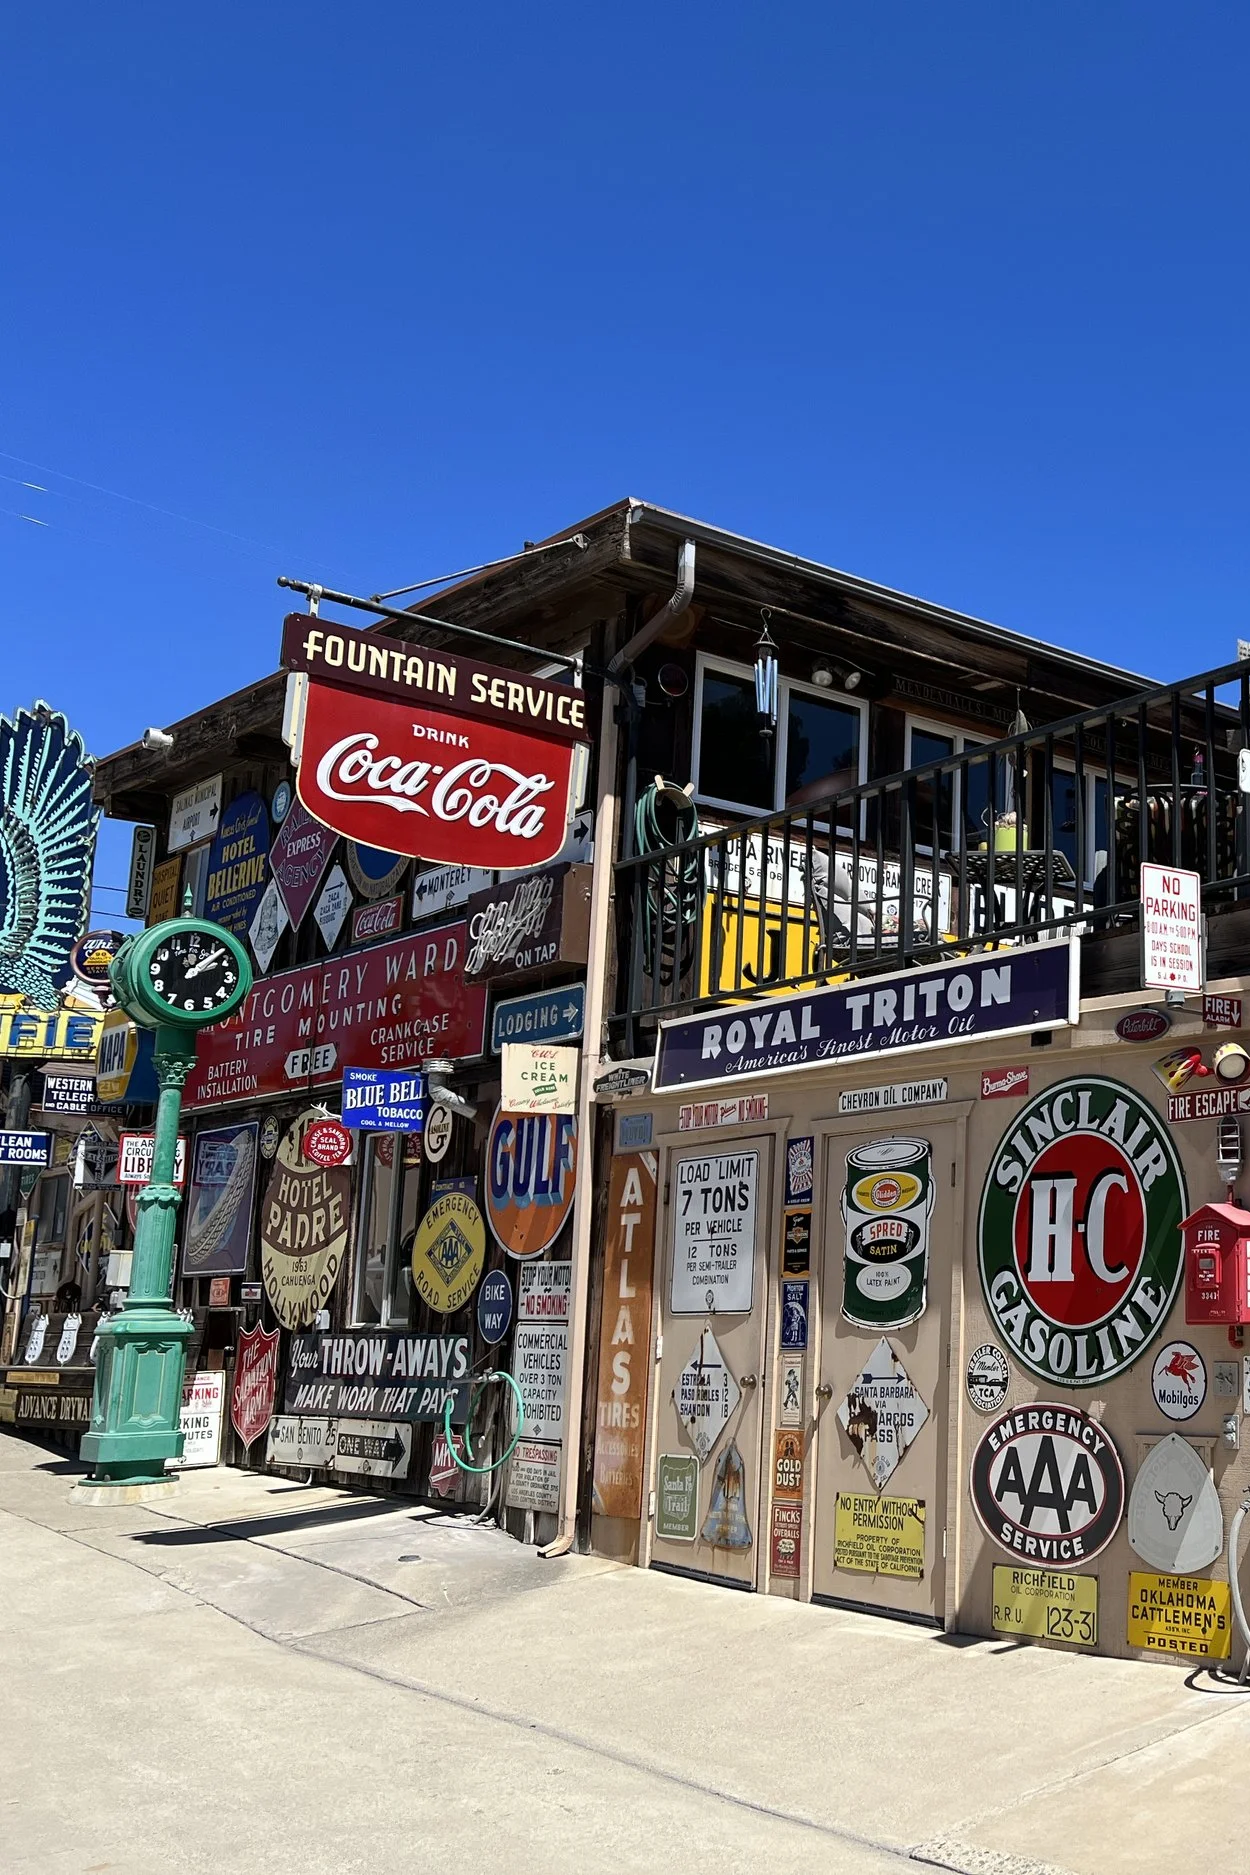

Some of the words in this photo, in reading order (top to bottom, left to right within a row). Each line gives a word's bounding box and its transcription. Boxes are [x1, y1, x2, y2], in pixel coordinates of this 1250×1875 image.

[303, 630, 457, 697] FOUNTAIN
[470, 673, 585, 729] SERVICE
[412, 723, 469, 748] DRINK
[316, 733, 555, 839] Coca-Cola
[222, 835, 255, 864] HOTEL
[287, 833, 321, 858] EXPRESS
[133, 843, 146, 907] LAUNDRY
[207, 853, 266, 901] BELLERIVE
[1162, 875, 1181, 896] NO
[1146, 897, 1196, 922] PARKING
[515, 951, 532, 968] ON
[534, 942, 557, 963] TAP
[1151, 939, 1168, 952] DAYS
[1169, 943, 1191, 956] SCHOOL
[701, 1006, 820, 1060] ROYAL
[846, 965, 1012, 1031] TRITON
[1205, 997, 1231, 1015] FIRE
[235, 1025, 276, 1051] TIRE
[298, 993, 402, 1037] MOUNTING
[498, 1005, 558, 1037] LODGING
[1205, 1013, 1231, 1023] ALARM
[370, 1013, 449, 1046] CRANKCASE
[101, 1031, 127, 1074] NAPA
[381, 1039, 434, 1063] SERVICE
[725, 1043, 808, 1074] America's
[816, 1033, 873, 1060] Finest
[880, 1024, 938, 1050] Motor
[948, 1014, 976, 1034] Oil
[208, 1059, 248, 1080] BATTERY
[291, 1049, 331, 1073] FREE
[535, 1062, 555, 1070] ICE
[47, 1077, 93, 1091] WESTERN
[197, 1075, 258, 1099] INSTALLATION
[350, 1073, 377, 1082] SMOKE
[521, 1072, 568, 1082] CREAM
[346, 1083, 385, 1109] BLUE
[389, 1079, 428, 1104] BELL
[841, 1091, 880, 1110] CHEVRON
[884, 1087, 897, 1105] OIL
[901, 1082, 944, 1103] COMPANY
[1168, 1096, 1192, 1120] FIRE
[1195, 1089, 1237, 1115] ESCAPE
[377, 1107, 423, 1121] TOBACCO
[317, 1143, 339, 1152] BRAND
[320, 1136, 337, 1144] SEAL
[997, 1090, 1168, 1194] SINCLAIR
[9, 1149, 47, 1160] ROOMS
[491, 1114, 576, 1210] GULF
[680, 1162, 711, 1185] LOAD
[718, 1157, 755, 1181] LIMIT
[278, 1172, 333, 1208] HOTEL
[682, 1190, 693, 1216] 7
[700, 1183, 749, 1214] TONS
[266, 1191, 344, 1249] PADRE
[426, 1196, 479, 1230] EMERGENCY
[685, 1222, 701, 1236] PER
[706, 1218, 743, 1234] VEHICLE
[869, 1221, 904, 1240] SPRED
[1027, 1172, 1130, 1283] H-C
[1198, 1229, 1220, 1242] FIRE
[687, 1246, 698, 1259] 12
[709, 1243, 737, 1258] TONS
[869, 1244, 898, 1256] SATIN
[686, 1261, 697, 1272] PER
[698, 1260, 737, 1271] SEMI-TRAILER
[416, 1269, 440, 1307] ROAD
[447, 1262, 481, 1309] SERVICE
[610, 1167, 646, 1396] ATLAS
[692, 1274, 729, 1286] COMBINATION
[866, 1276, 884, 1287] LATEX
[884, 1276, 900, 1287] PAINT
[485, 1284, 505, 1301] BIKE
[484, 1313, 503, 1329] WAY
[991, 1271, 1167, 1377] GASOLINE
[517, 1333, 568, 1351] COMMERCIAL
[291, 1339, 319, 1377] Your
[322, 1338, 468, 1379] THROW-AWAYS
[523, 1353, 561, 1370] VEHICLES
[519, 1373, 538, 1384] OVER
[541, 1373, 546, 1385] 3
[548, 1374, 562, 1386] TON
[294, 1384, 333, 1410] MAKE
[337, 1386, 376, 1412] WORK
[381, 1386, 417, 1414] THAT
[417, 1388, 459, 1415] PAYS
[523, 1388, 557, 1400] CAPACITY
[854, 1386, 878, 1399] SANTA
[879, 1386, 914, 1399] BARBARA
[978, 1388, 995, 1399] TCA
[1158, 1388, 1200, 1408] Mobilgas
[875, 1400, 887, 1409] VIA
[600, 1402, 640, 1429] TIRES
[280, 1425, 295, 1444] SAN
[298, 1426, 322, 1445] BENITO
[325, 1428, 336, 1446] 25
[987, 1412, 1106, 1454] EMERGENCY
[338, 1436, 360, 1455] ONE
[364, 1437, 388, 1458] WAY
[777, 1458, 800, 1474] GOLD
[776, 1472, 800, 1488] DUST
[994, 1435, 1097, 1534] AAA
[840, 1498, 851, 1510] NO
[853, 1498, 879, 1514] ENTRY
[881, 1502, 918, 1517] WITHOUT
[663, 1523, 689, 1532] MEMBER
[852, 1512, 904, 1531] PERMISSION
[837, 1540, 865, 1550] RICHFIELD
[866, 1542, 877, 1551] OIL
[878, 1544, 921, 1557] CORPORATION
[856, 1534, 888, 1543] PROPERTY
[891, 1537, 900, 1545] OF
[1000, 1523, 1085, 1560] SERVICE
[1012, 1570, 1075, 1592] RICHFIELD
[1158, 1577, 1199, 1591] MEMBER
[1011, 1586, 1024, 1595] OIL
[1025, 1587, 1076, 1602] CORPORATION
[1140, 1589, 1217, 1611] OKLAHOMA
[1131, 1605, 1226, 1630] CATTLEMEN'S
[1147, 1636, 1209, 1654] POSTED
